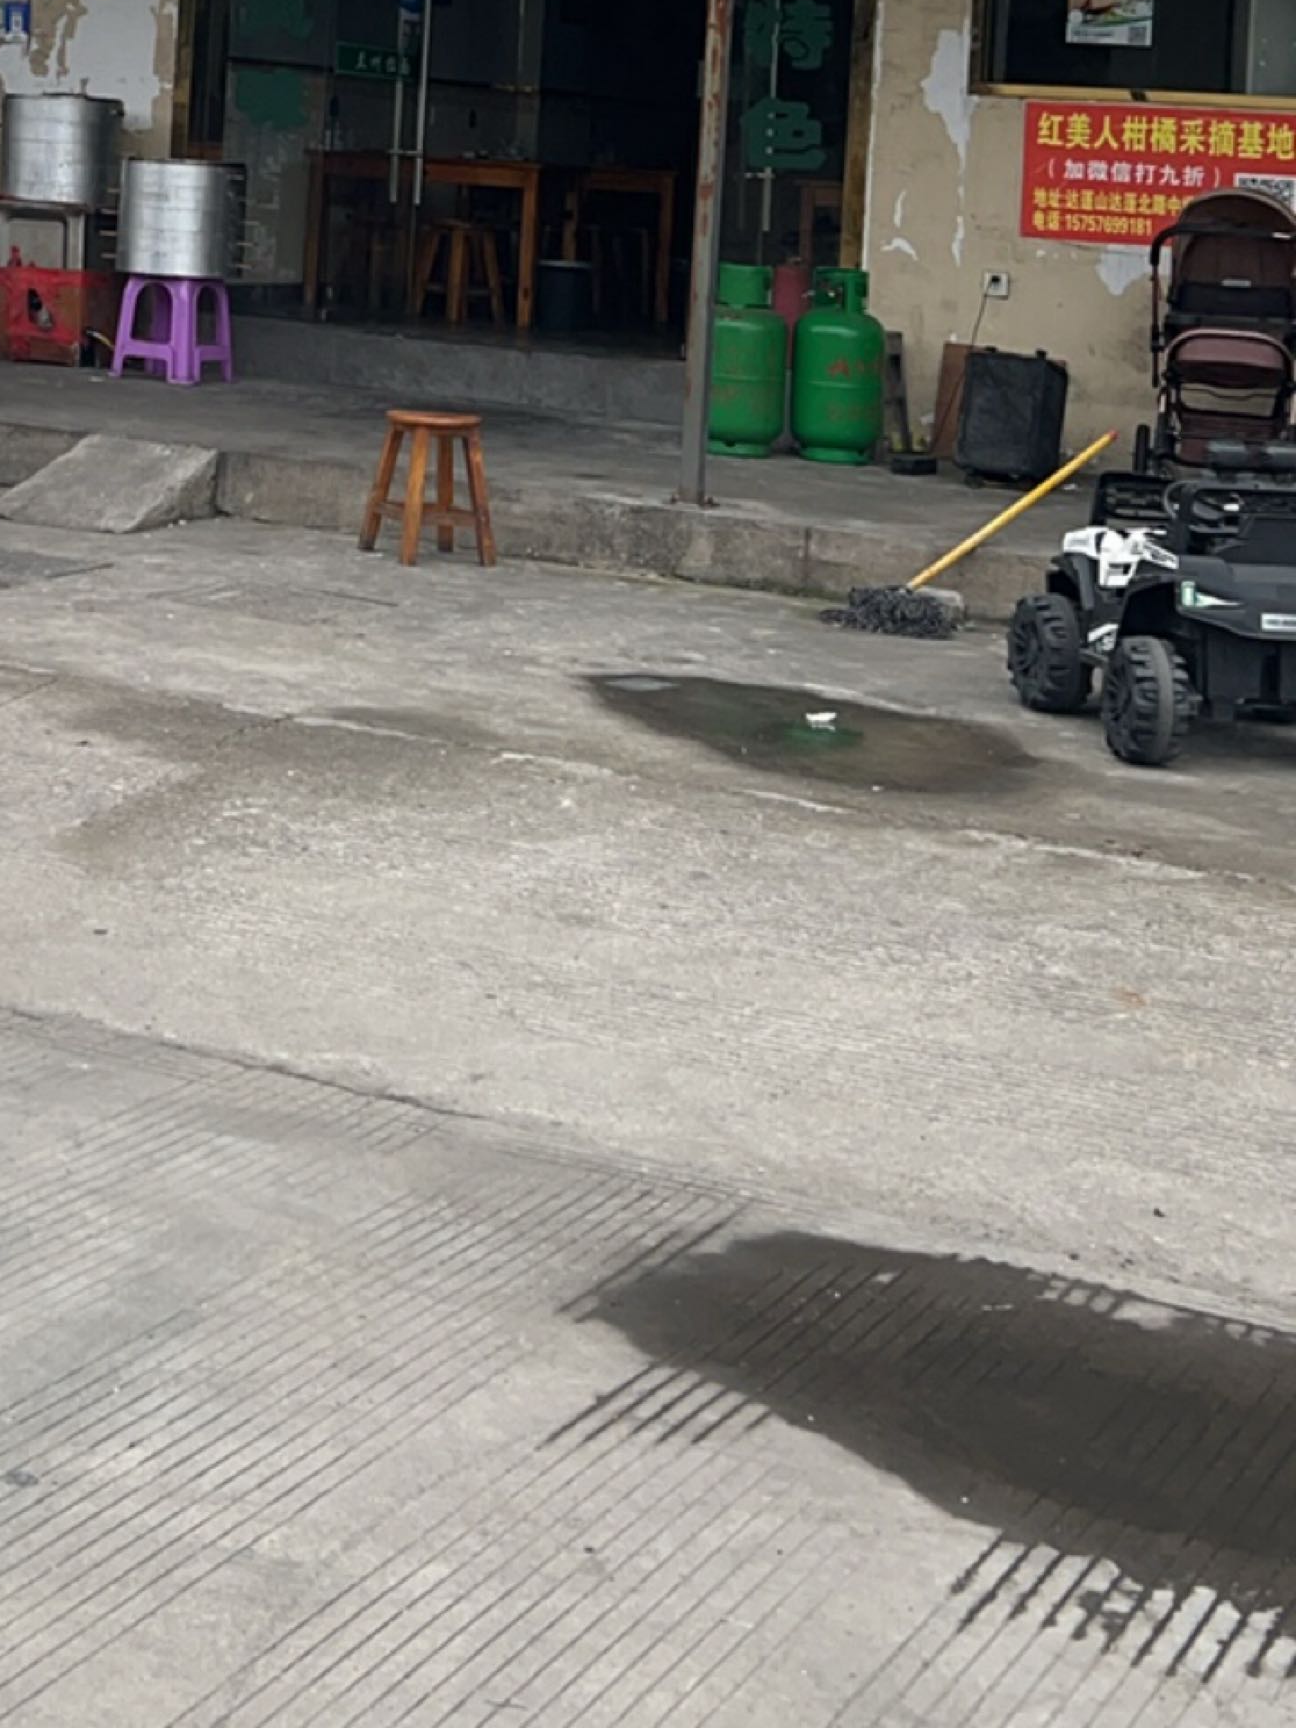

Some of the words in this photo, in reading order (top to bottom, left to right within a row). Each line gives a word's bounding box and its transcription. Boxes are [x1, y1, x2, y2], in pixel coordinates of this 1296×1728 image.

[1036, 111, 1296, 160] 红美人柑橘采摘基地
